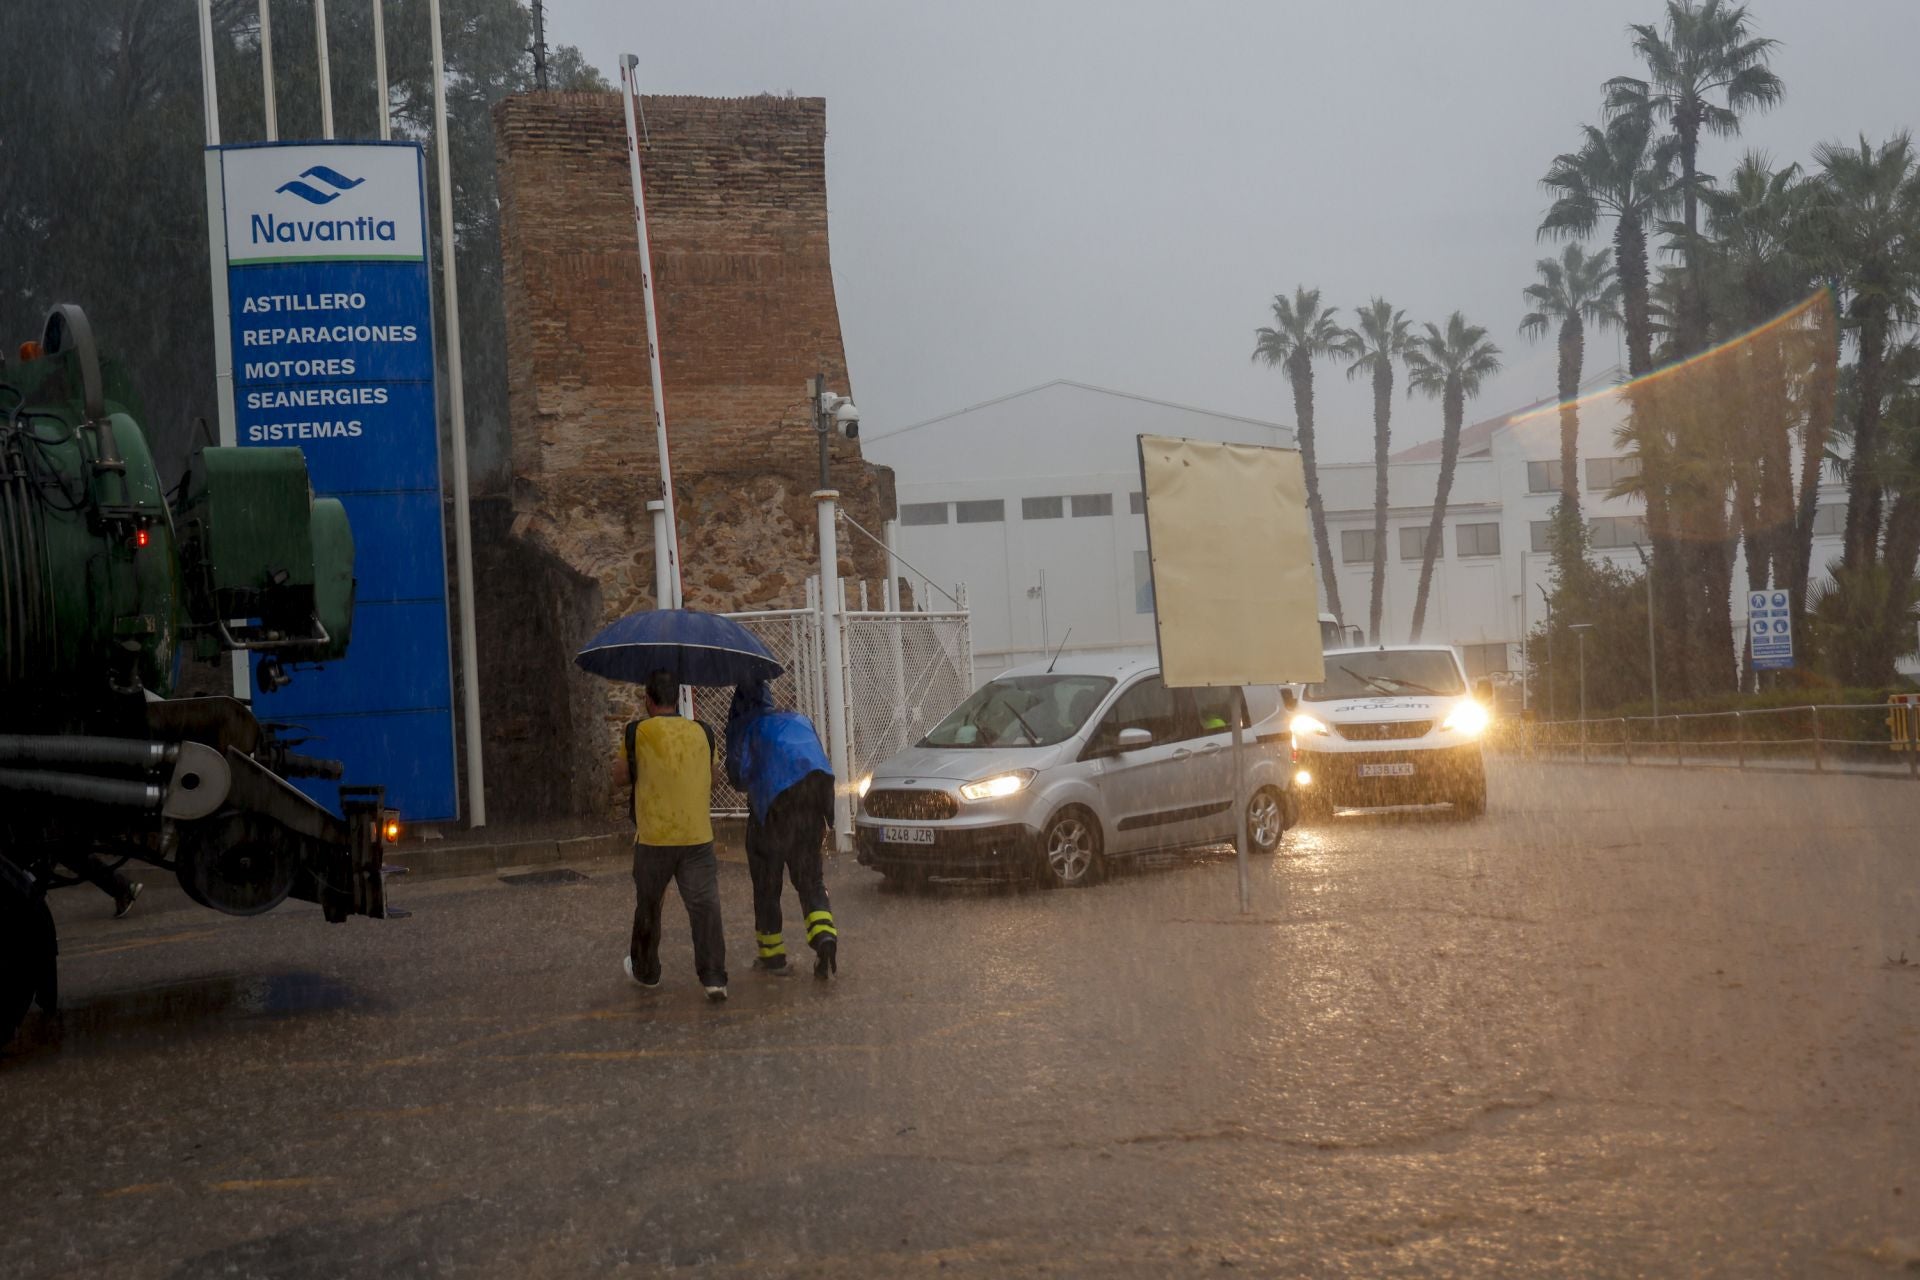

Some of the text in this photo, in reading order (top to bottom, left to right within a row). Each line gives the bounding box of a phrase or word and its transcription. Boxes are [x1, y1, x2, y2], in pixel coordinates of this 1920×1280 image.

[251, 213, 396, 244] Navantia
[243, 293, 366, 314] ASTILLERO
[243, 325, 417, 346] REPARACIONES
[245, 358, 356, 380] MOTORES
[247, 388, 388, 410] SEANERGIES
[249, 420, 363, 442] SISTEMAS
[886, 829, 932, 842] 4248 JZR
